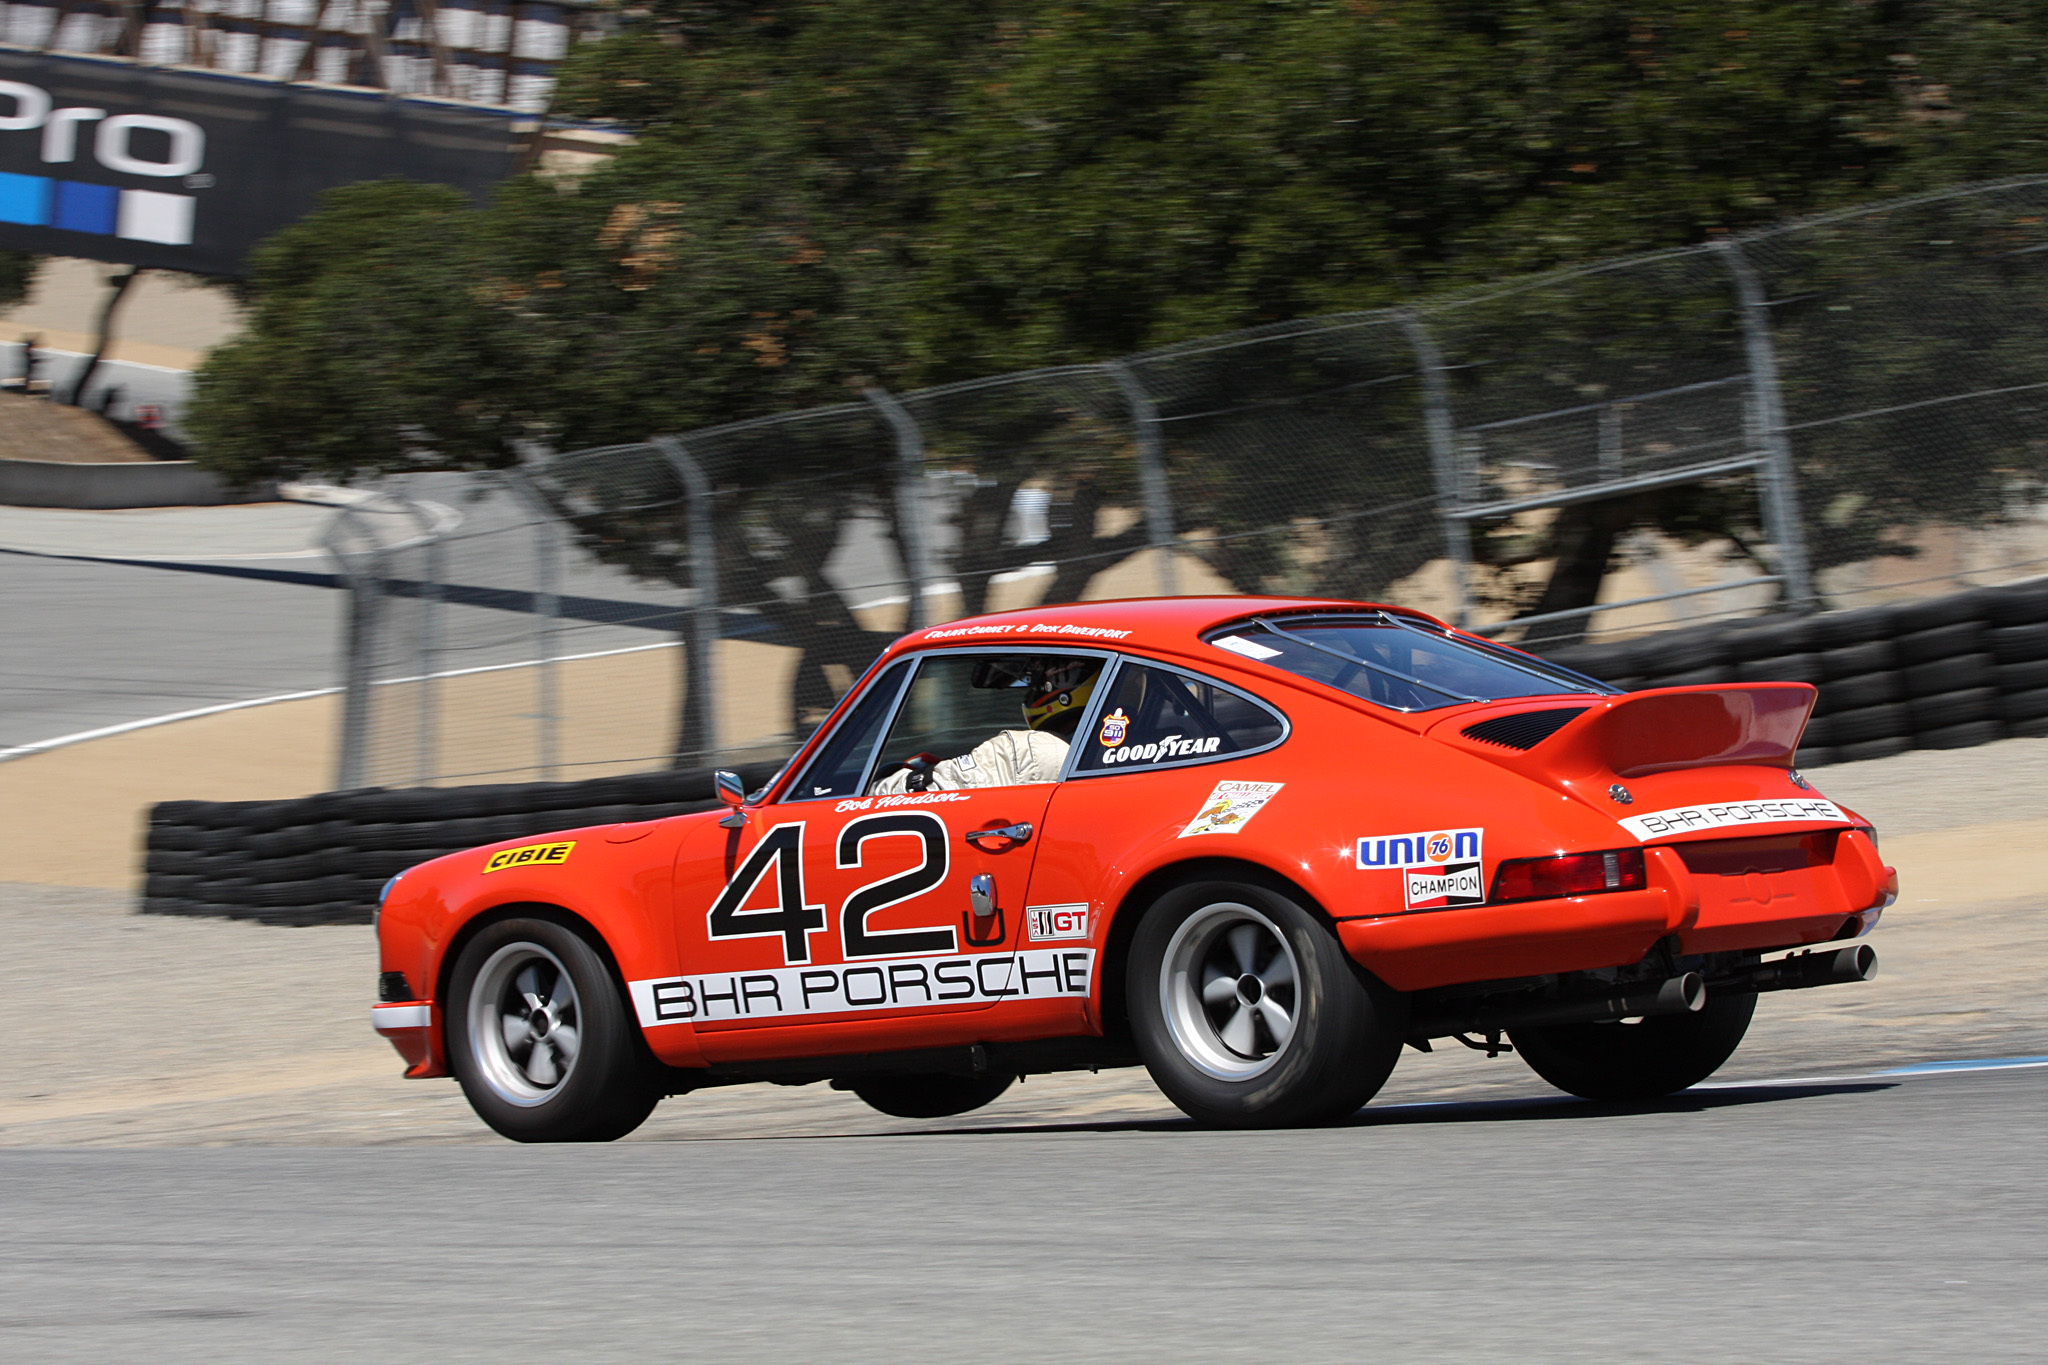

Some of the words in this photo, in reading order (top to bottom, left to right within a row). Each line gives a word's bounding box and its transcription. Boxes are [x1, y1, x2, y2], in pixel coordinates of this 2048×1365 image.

[924, 628, 969, 639] FRANK
[1030, 624, 1061, 632] DICK
[1058, 624, 1133, 639] DAVENPORT
[1103, 730, 1122, 738] 911
[1102, 735, 1220, 764] GOODYEAR
[1217, 783, 1276, 793] CAMEL
[834, 798, 873, 812] Bob
[874, 792, 971, 810] Hindson
[1640, 810, 1709, 833] BHR
[1708, 803, 1838, 822] PORSCHE
[1430, 838, 1450, 856] 76
[706, 810, 959, 966] 42
[1411, 875, 1479, 896] CHAMPION
[1054, 911, 1086, 931] GT
[652, 974, 783, 1021] BHR
[800, 953, 1088, 1010] PORSCHE
